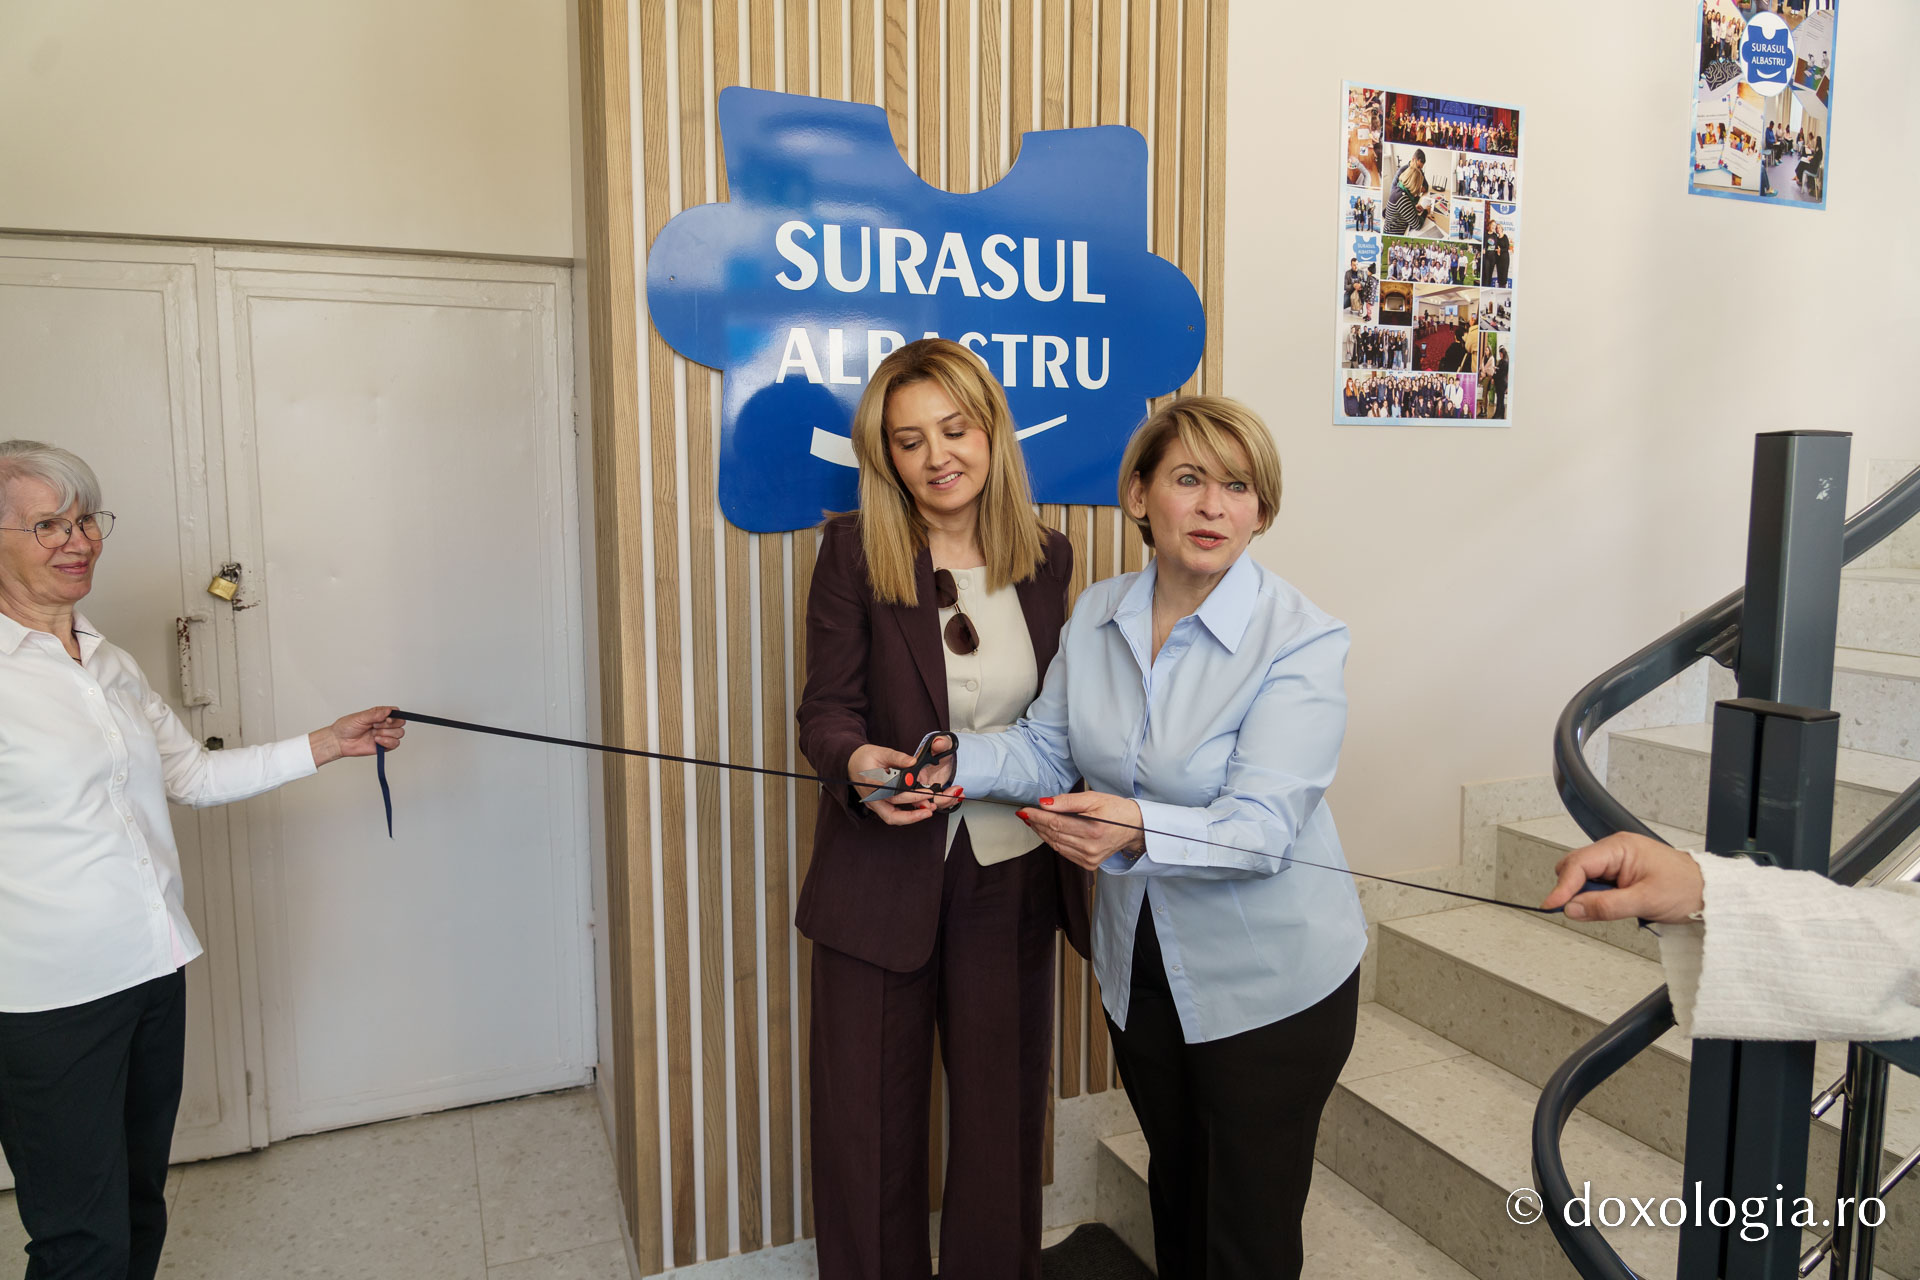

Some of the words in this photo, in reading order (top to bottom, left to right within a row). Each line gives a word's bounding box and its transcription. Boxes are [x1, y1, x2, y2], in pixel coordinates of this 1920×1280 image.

[1751, 42, 1786, 54] SURASUL
[1751, 56, 1786, 66] ALBASTRU
[776, 221, 1106, 304] SURASUL
